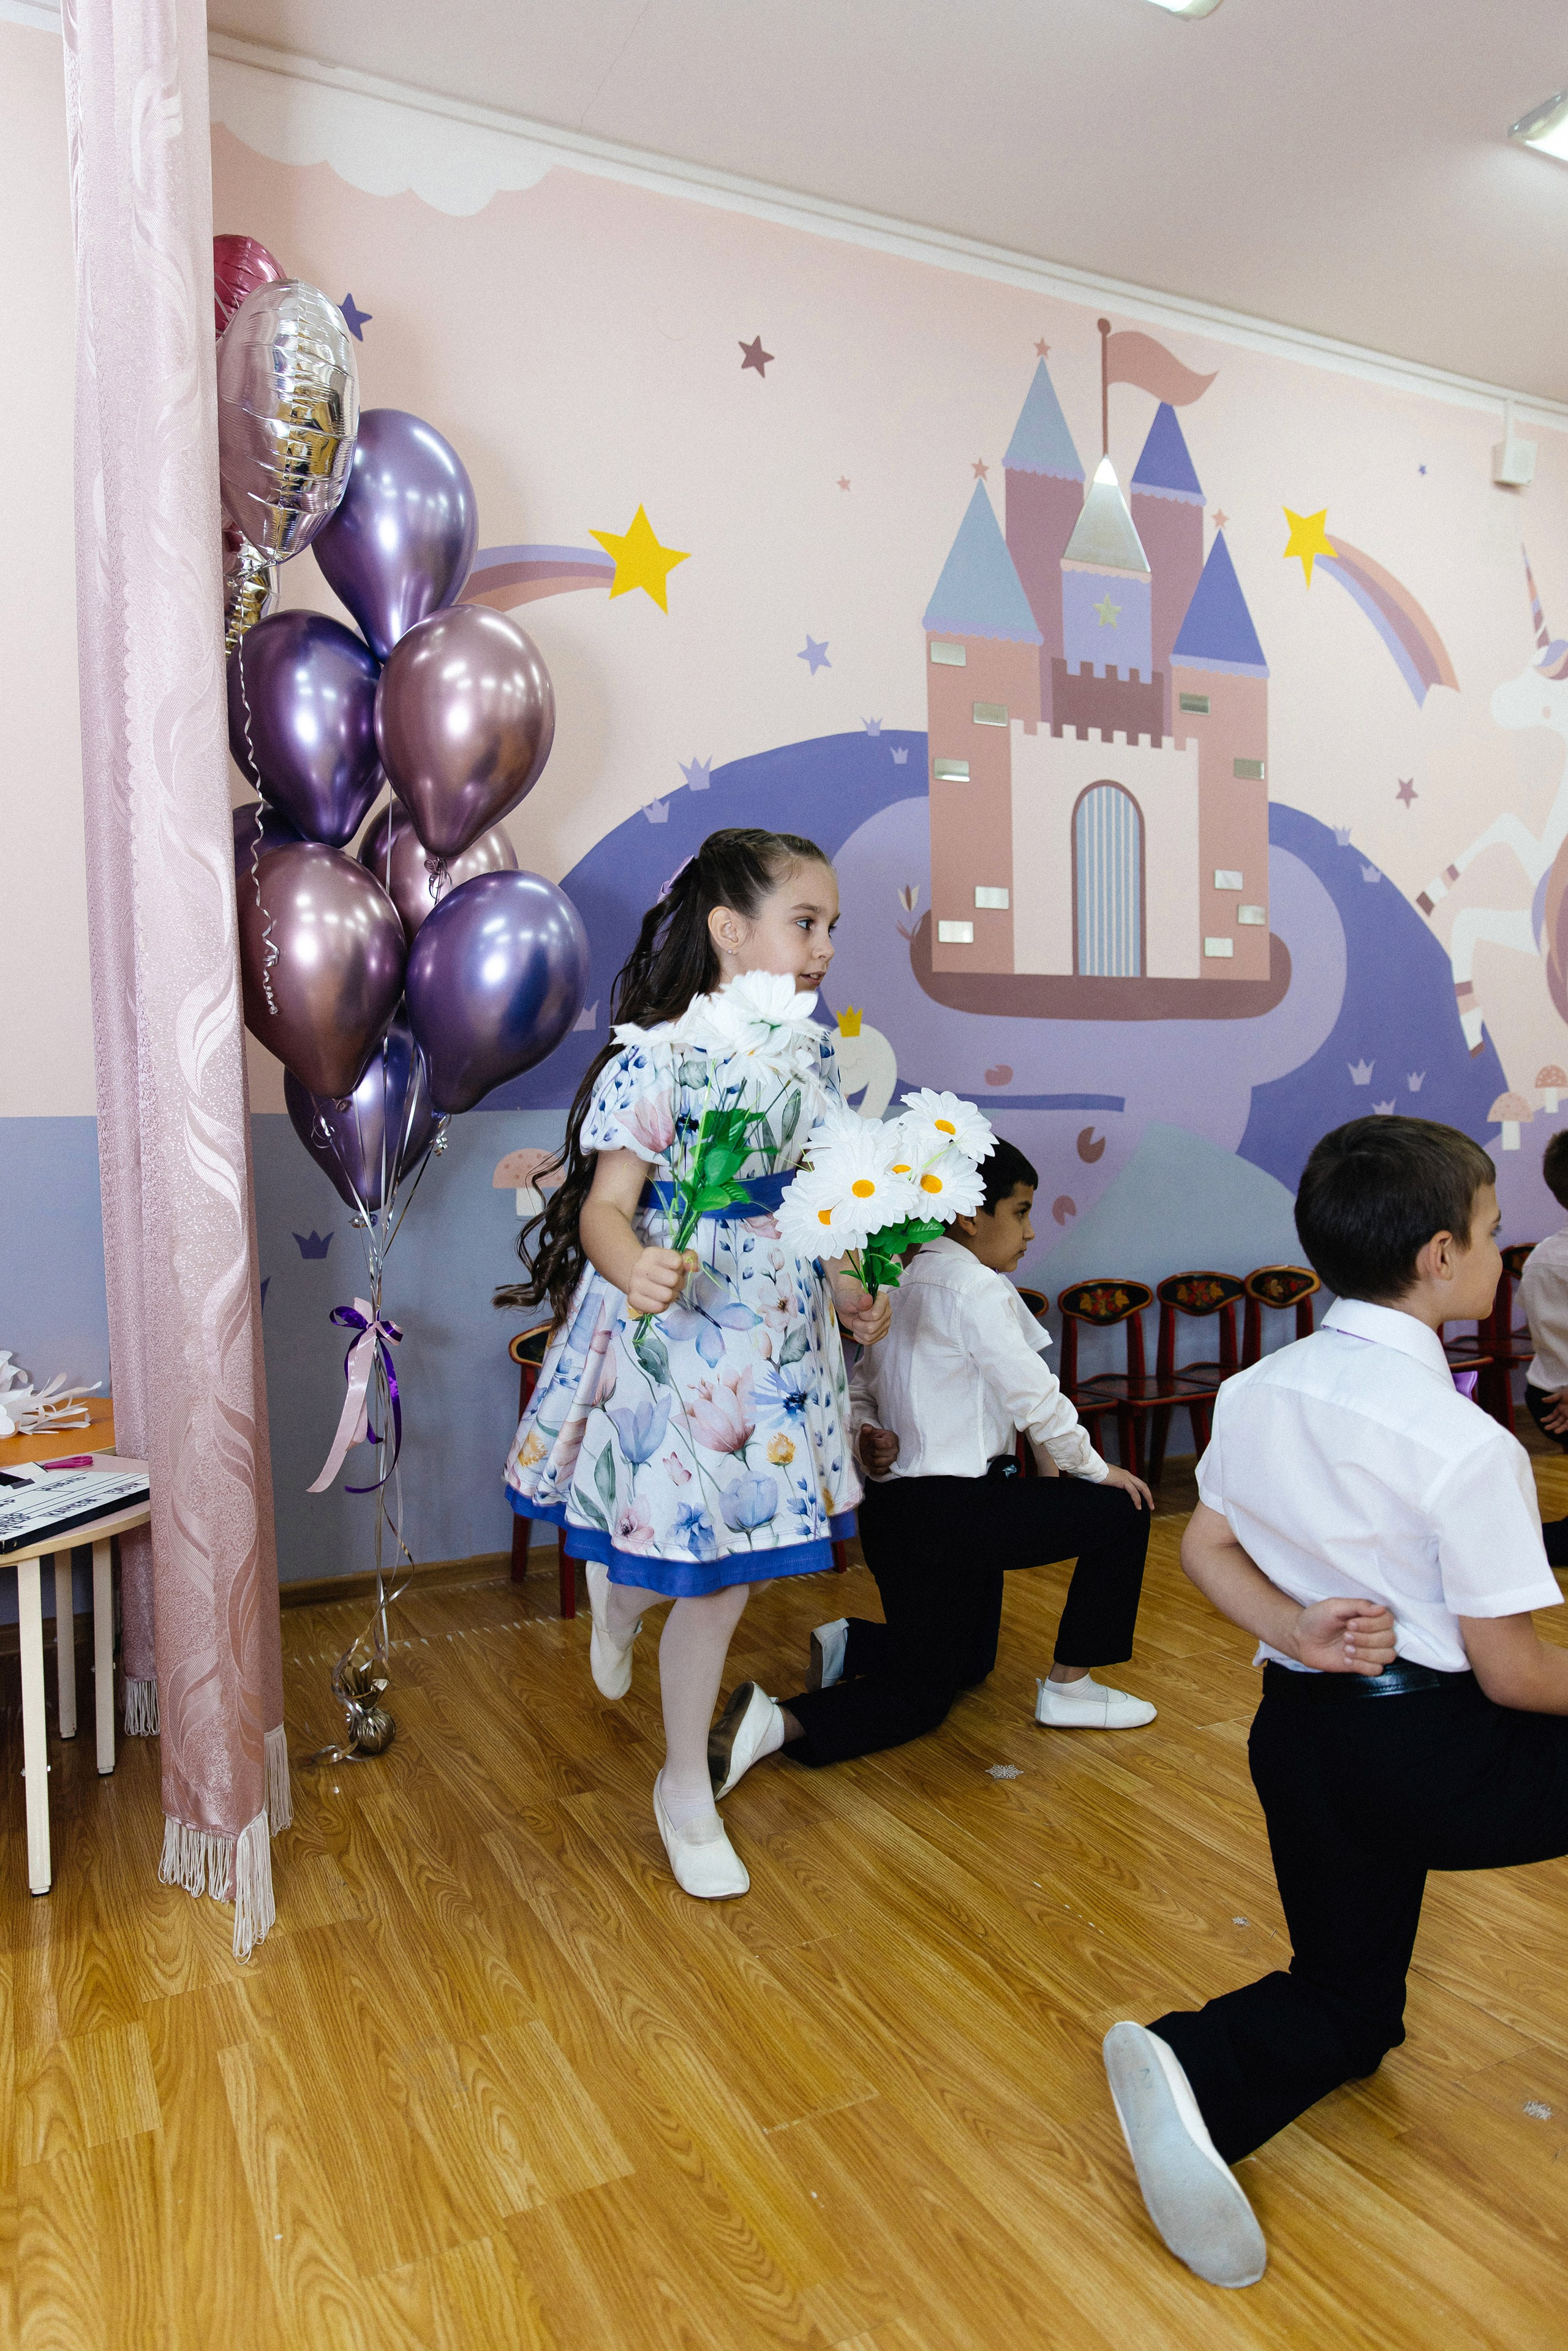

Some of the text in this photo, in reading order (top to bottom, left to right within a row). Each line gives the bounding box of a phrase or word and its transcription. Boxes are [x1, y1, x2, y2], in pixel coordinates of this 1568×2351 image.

[40, 1476, 87, 1491] ДУБЛЬ
[107, 1482, 147, 1493] ЗВУК
[43, 1498, 103, 1516] КАМЕРА
